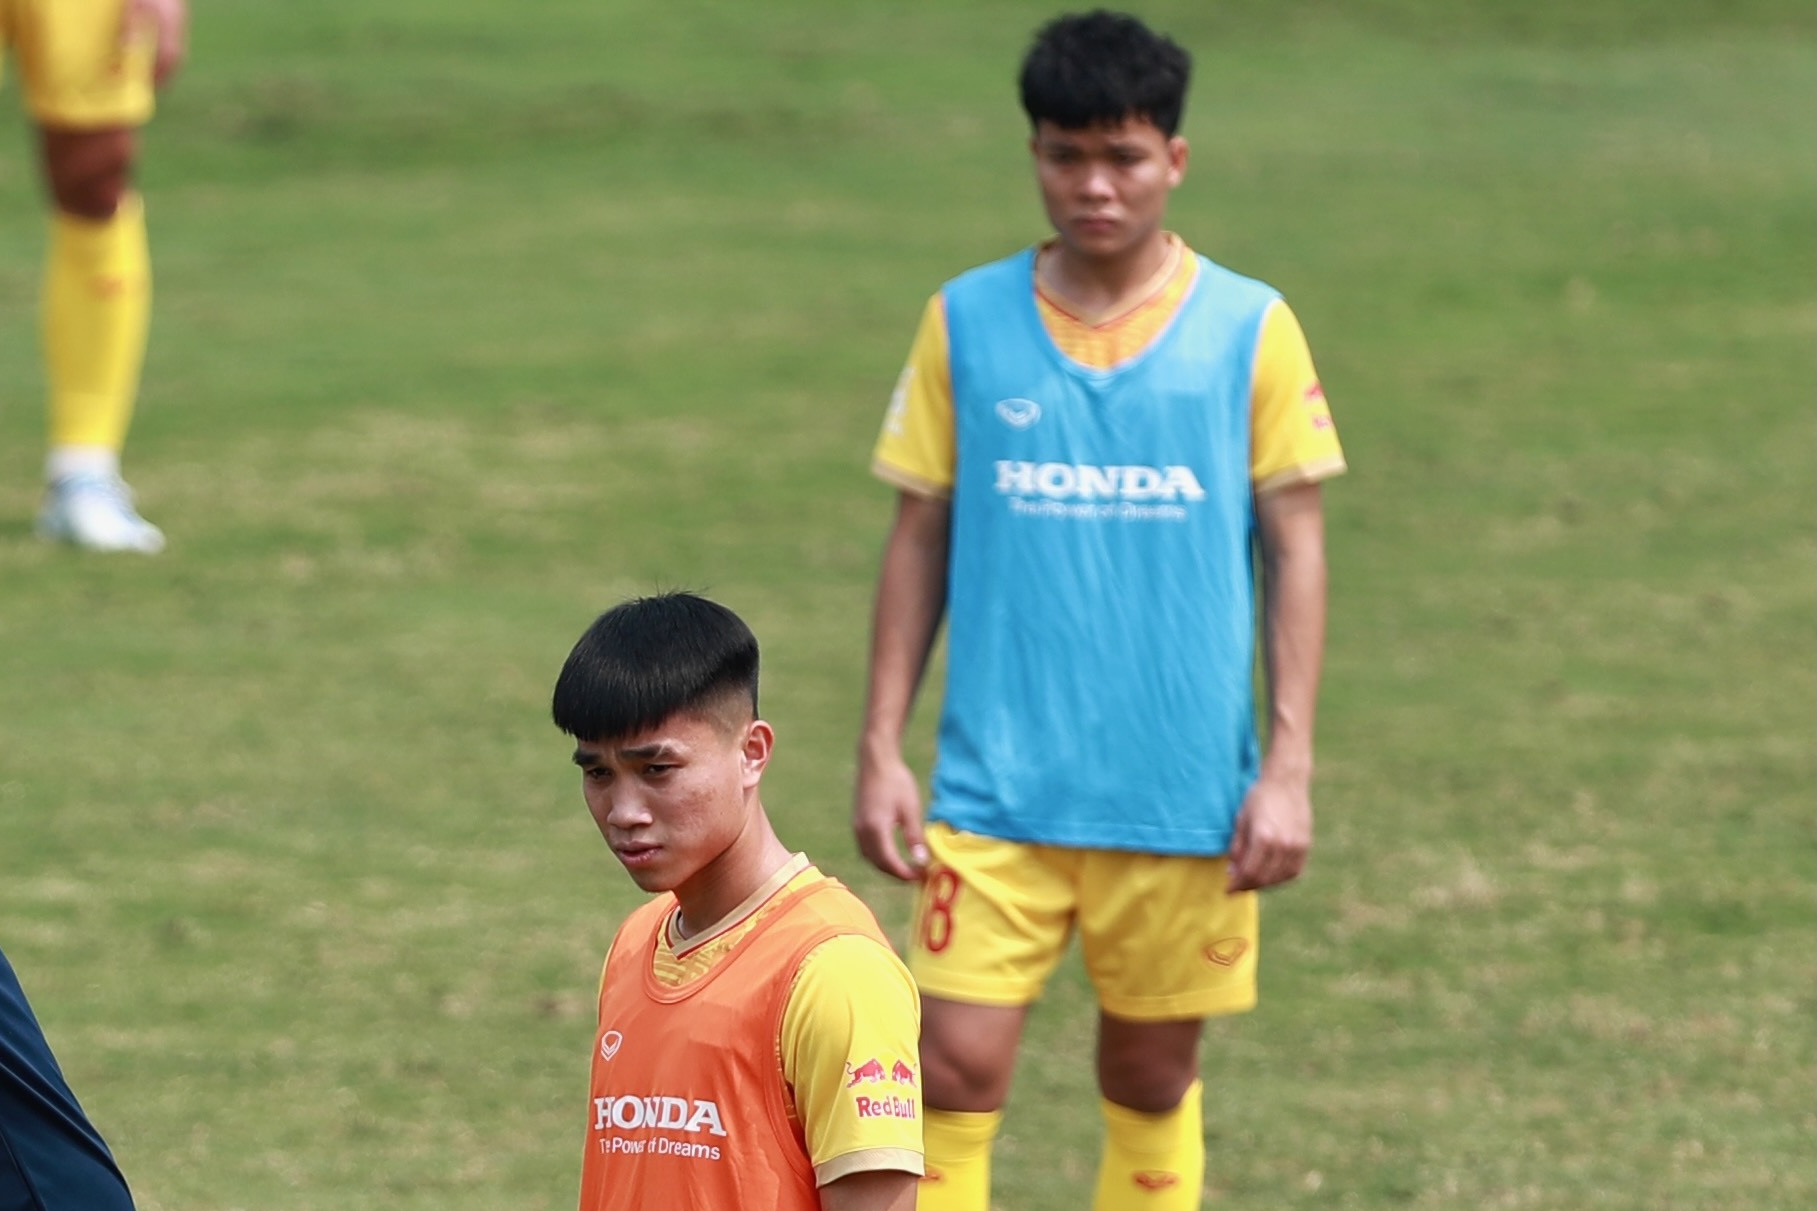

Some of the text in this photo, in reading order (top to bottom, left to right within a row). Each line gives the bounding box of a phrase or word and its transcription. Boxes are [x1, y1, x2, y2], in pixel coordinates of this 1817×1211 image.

[994, 459, 1207, 500] HONDA
[914, 864, 961, 955] 8
[594, 1095, 727, 1136] HONDA
[856, 1096, 916, 1119] Red Bull
[658, 1138, 721, 1160] Dreams
